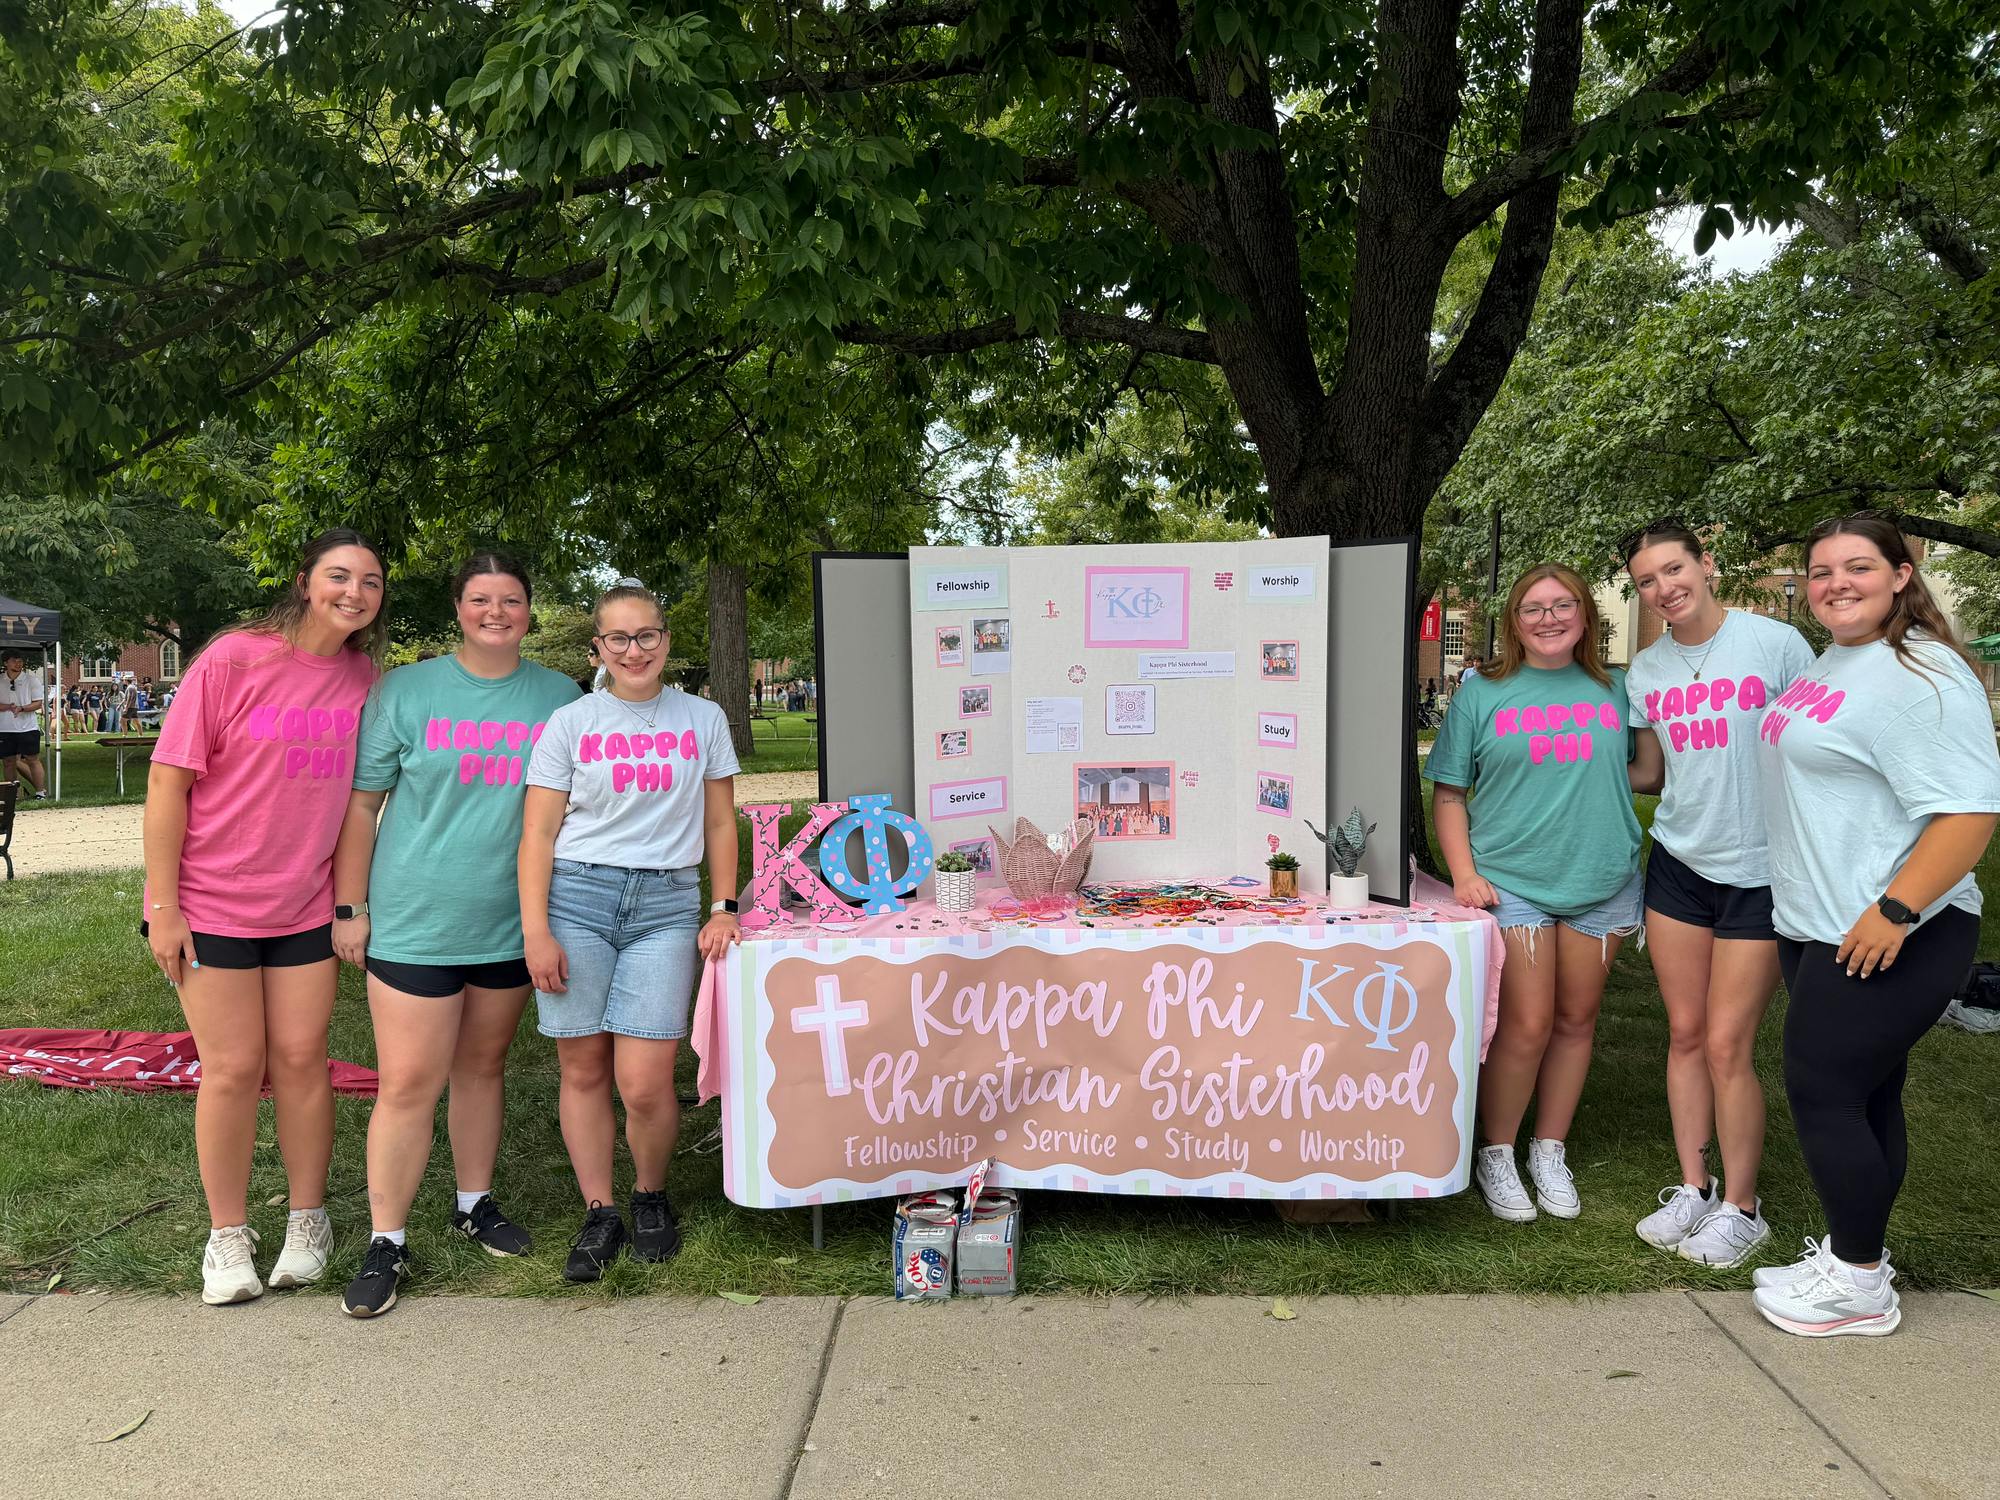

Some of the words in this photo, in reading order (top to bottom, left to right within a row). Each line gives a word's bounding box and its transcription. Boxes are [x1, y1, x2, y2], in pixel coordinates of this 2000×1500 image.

[936, 580, 990, 591] Fellowship
[1262, 575, 1299, 587] Worship
[1645, 675, 1767, 723] KAPPA
[1774, 675, 1847, 724] APPA
[249, 704, 355, 742] KAPP
[1264, 724, 1290, 738] Study
[1495, 702, 1621, 737] KAPPA
[1669, 717, 1729, 753] PHI
[1760, 710, 1791, 749] PHI
[286, 746, 345, 779] PHI
[578, 729, 699, 764] KAPPA
[1529, 732, 1593, 765] PHI
[459, 753, 522, 786] PHI
[611, 762, 673, 794] PHI
[949, 791, 986, 803] Service
[911, 970, 1123, 1051] Kappa
[1143, 957, 1264, 1040] Phi
[853, 1050, 1122, 1125] Christian
[1140, 1041, 1435, 1128] Sisterhood
[844, 1130, 978, 1168] Fellowship
[1022, 1119, 1117, 1158] Service
[1164, 1127, 1249, 1173] Study
[1300, 1130, 1405, 1171] Worship
[907, 1250, 929, 1292] Coke
